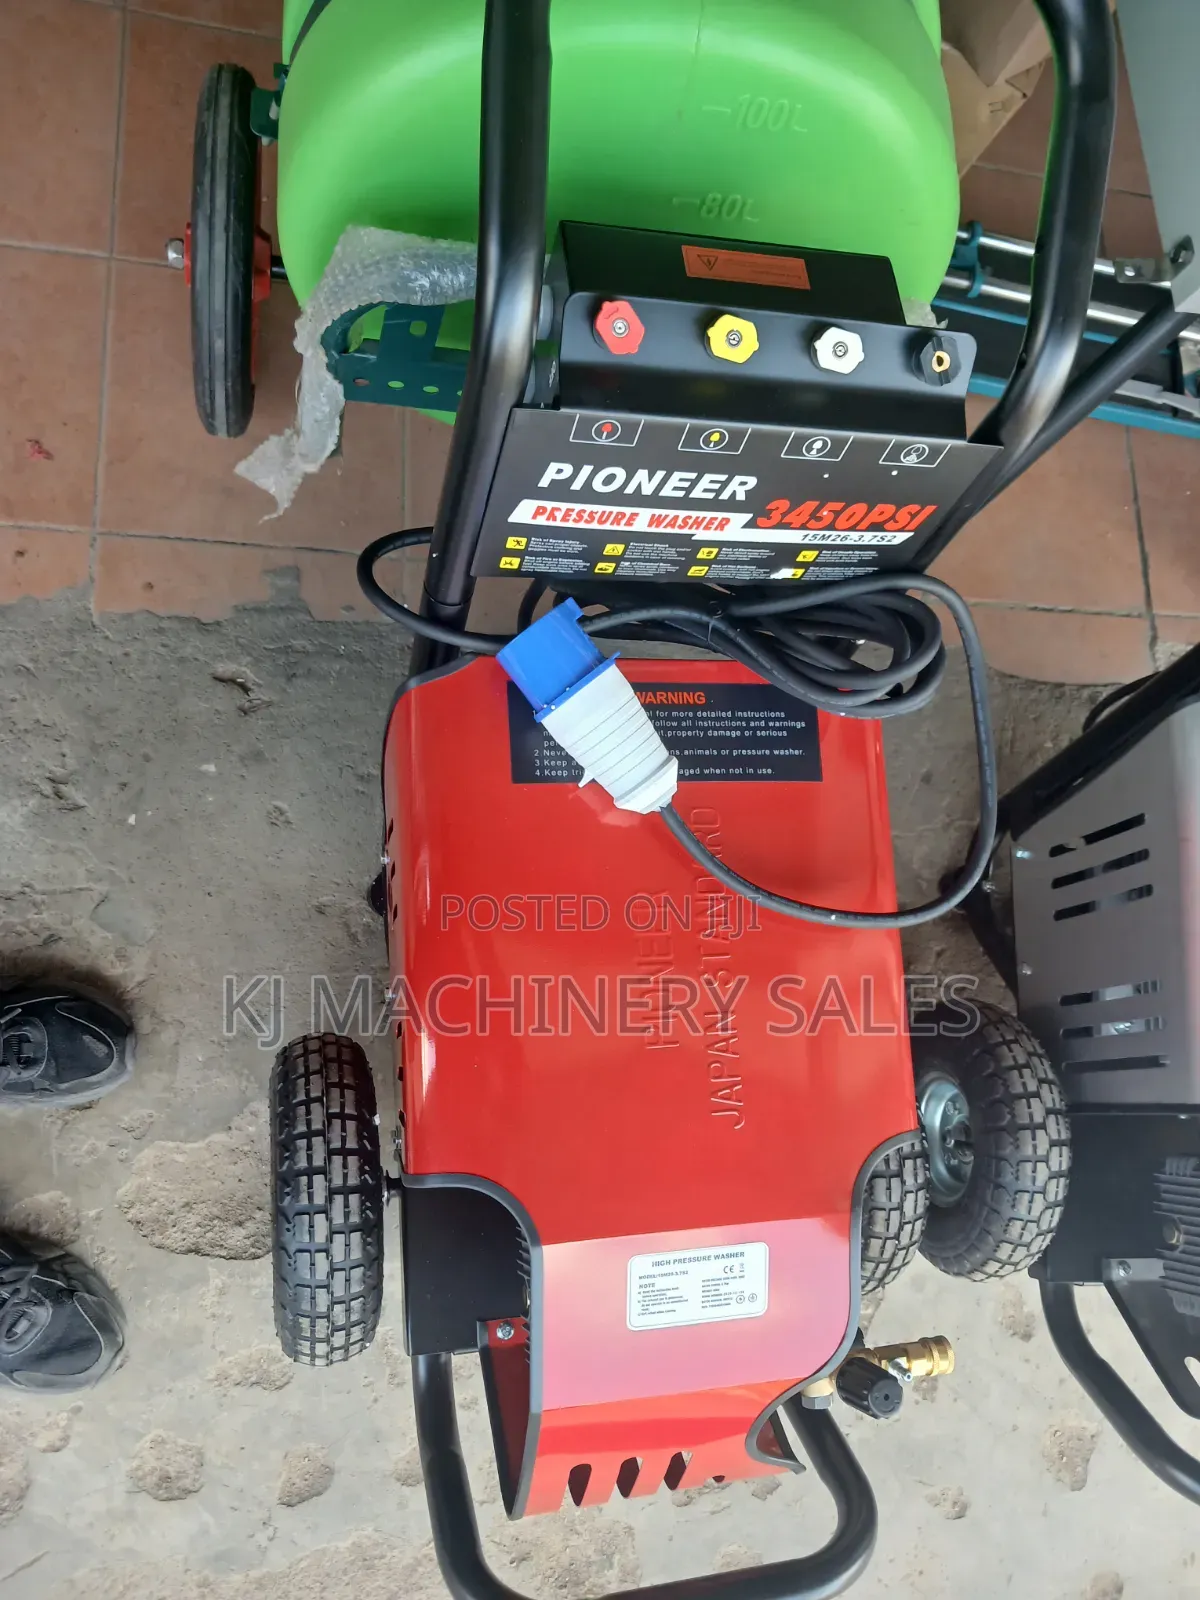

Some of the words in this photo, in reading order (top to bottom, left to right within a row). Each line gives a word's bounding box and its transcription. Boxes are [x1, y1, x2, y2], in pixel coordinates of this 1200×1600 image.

[537, 461, 758, 501] PIONEER
[531, 504, 637, 527] PRESSURE
[647, 513, 731, 532] WASHER
[756, 498, 938, 531] 3450PSI
[635, 691, 707, 704] WARNING
[697, 710, 732, 718] detailed
[735, 710, 785, 718] instructions
[768, 720, 806, 729] warnings
[708, 729, 741, 738] damage
[757, 729, 787, 737] serious
[534, 760, 568, 768] 3.Keep
[535, 769, 569, 778] 4.Keep
[757, 767, 775, 775] use.
[704, 1009, 746, 1130] JAPAN
[652, 1259, 671, 1267] HIGH
[673, 1255, 712, 1264] PRESSURE
[713, 1252, 745, 1260] WASHER
